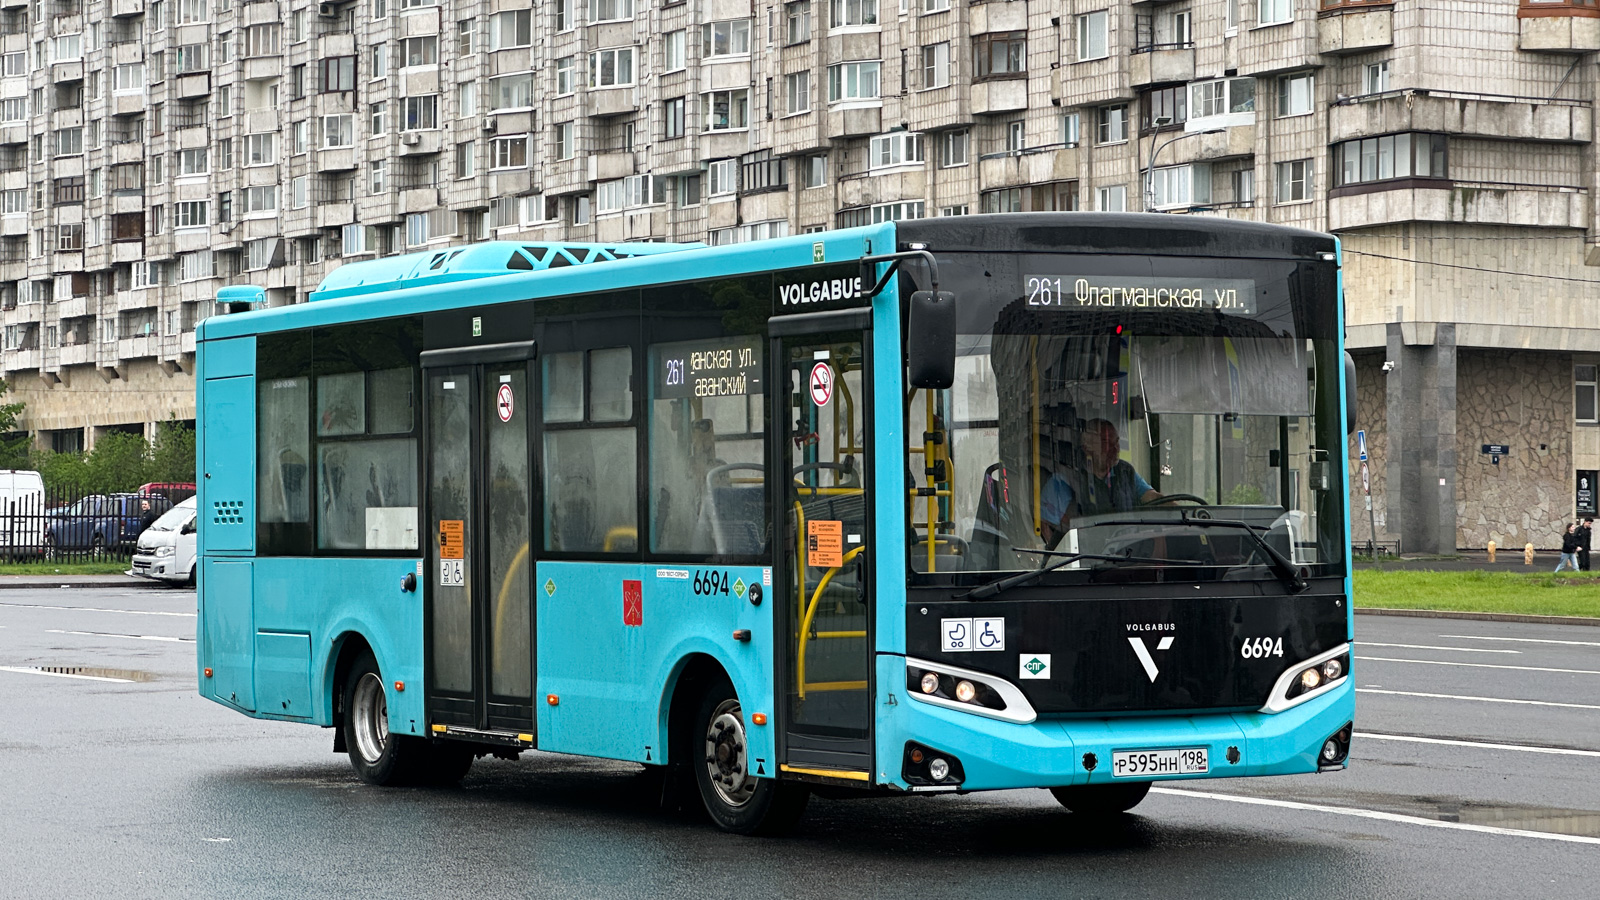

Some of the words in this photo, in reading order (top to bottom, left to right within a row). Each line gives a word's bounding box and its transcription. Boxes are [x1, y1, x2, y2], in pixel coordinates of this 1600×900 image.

[779, 276, 861, 306] VOLGABUS
[1028, 278, 1061, 306] 261
[1075, 278, 1202, 308] Флагманская
[1215, 289, 1245, 309] ул.
[739, 347, 756, 368] ул.
[666, 359, 684, 385] 261
[693, 569, 730, 597] 6694
[1126, 623, 1176, 631] VOLGABUS
[1241, 636, 1284, 659] 6694
[1026, 662, 1042, 671] СПГ
[1181, 750, 1203, 766] 198
